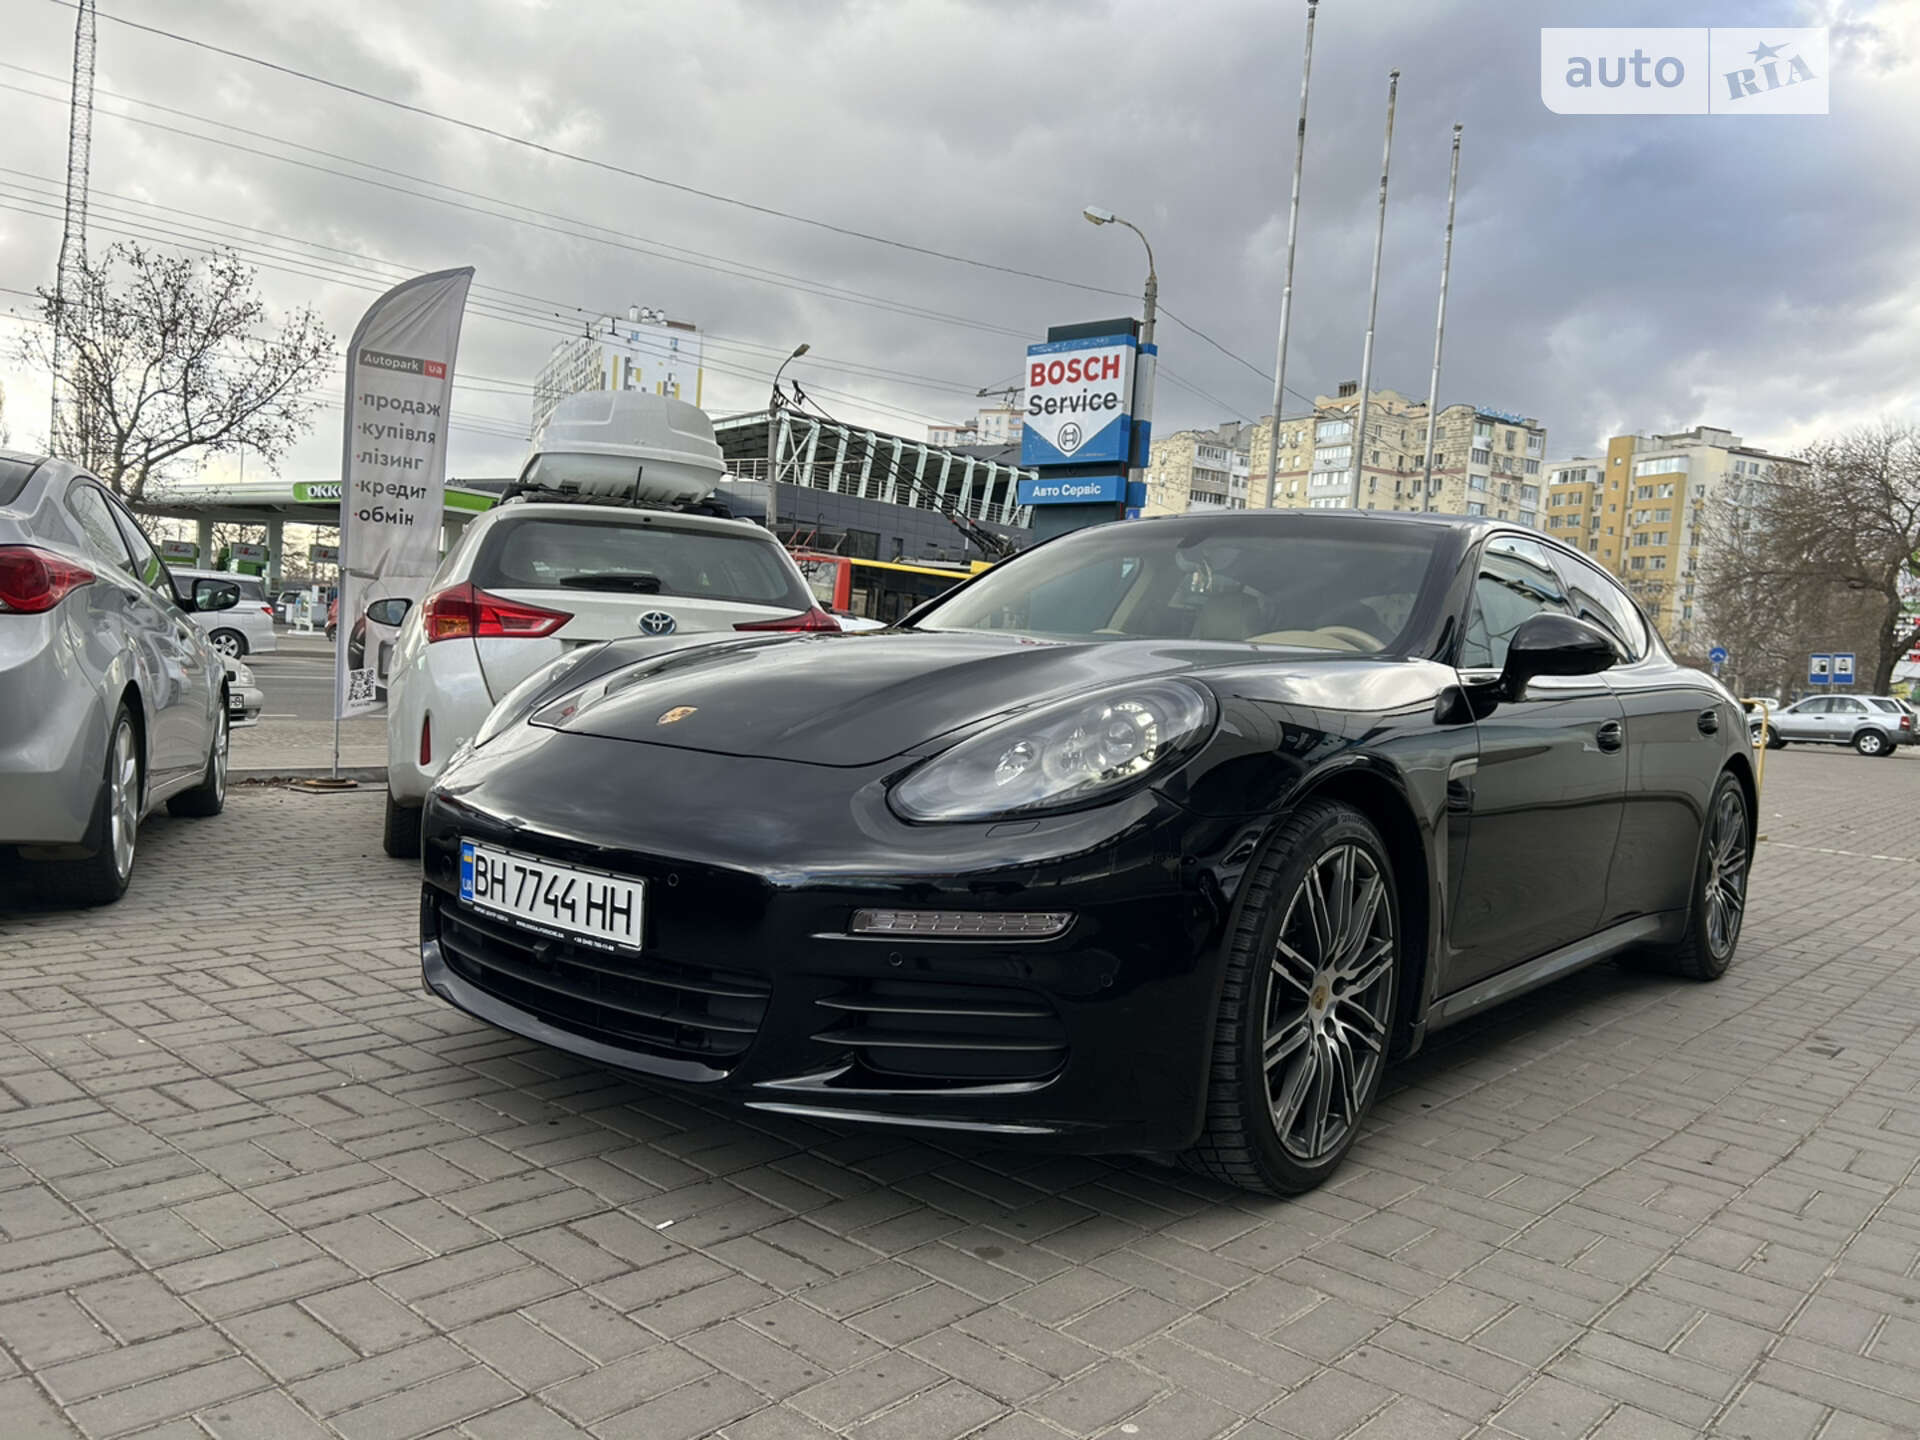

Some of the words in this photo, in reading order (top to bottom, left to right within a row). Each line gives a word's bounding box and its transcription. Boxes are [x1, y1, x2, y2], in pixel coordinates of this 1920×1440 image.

[364, 354, 419, 371] Autopark
[1030, 354, 1120, 387] BOSCH
[363, 394, 441, 416] продаж
[1028, 388, 1118, 416] Service
[362, 422, 436, 444] купівля
[361, 448, 424, 470] лізинг
[360, 480, 427, 500] кредит
[1032, 485, 1059, 497] Авто
[1061, 483, 1101, 497] Сервіс
[359, 506, 414, 526] обмін
[475, 855, 507, 904] BH
[514, 864, 577, 923] 7744
[585, 881, 633, 936] HH
